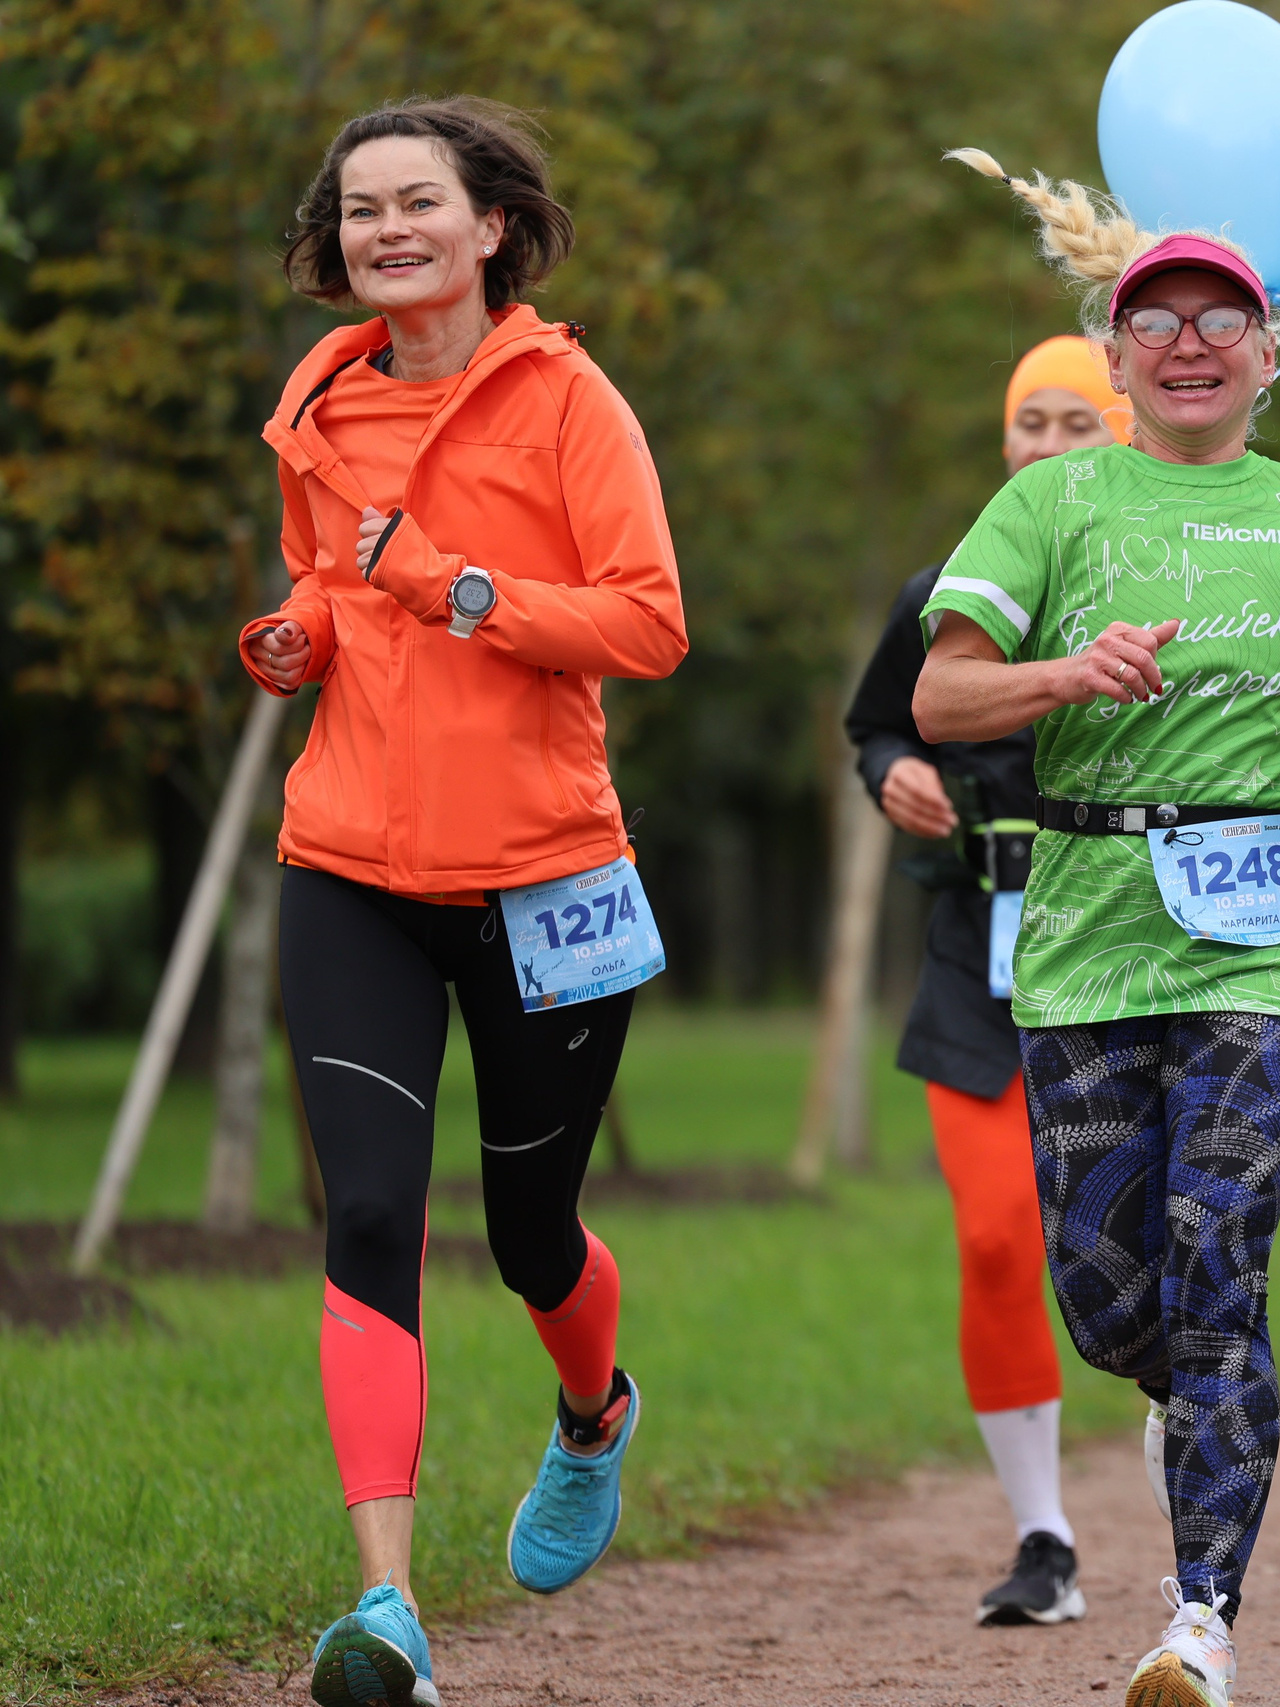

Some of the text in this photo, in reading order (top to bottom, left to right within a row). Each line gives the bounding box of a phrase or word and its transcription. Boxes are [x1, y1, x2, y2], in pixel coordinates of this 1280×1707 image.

[1221, 824, 1261, 838] СЕНЕЖСКАЯ
[576, 870, 611, 890] СЕНЕЖСКАЯ
[1213, 894, 1255, 910] 10.55
[535, 884, 638, 950] 1274
[1221, 914, 1280, 928] МАРГАРИТА
[572, 938, 613, 961] 10.55
[591, 958, 626, 977] ОЛЬГА
[573, 982, 601, 999] 2024
